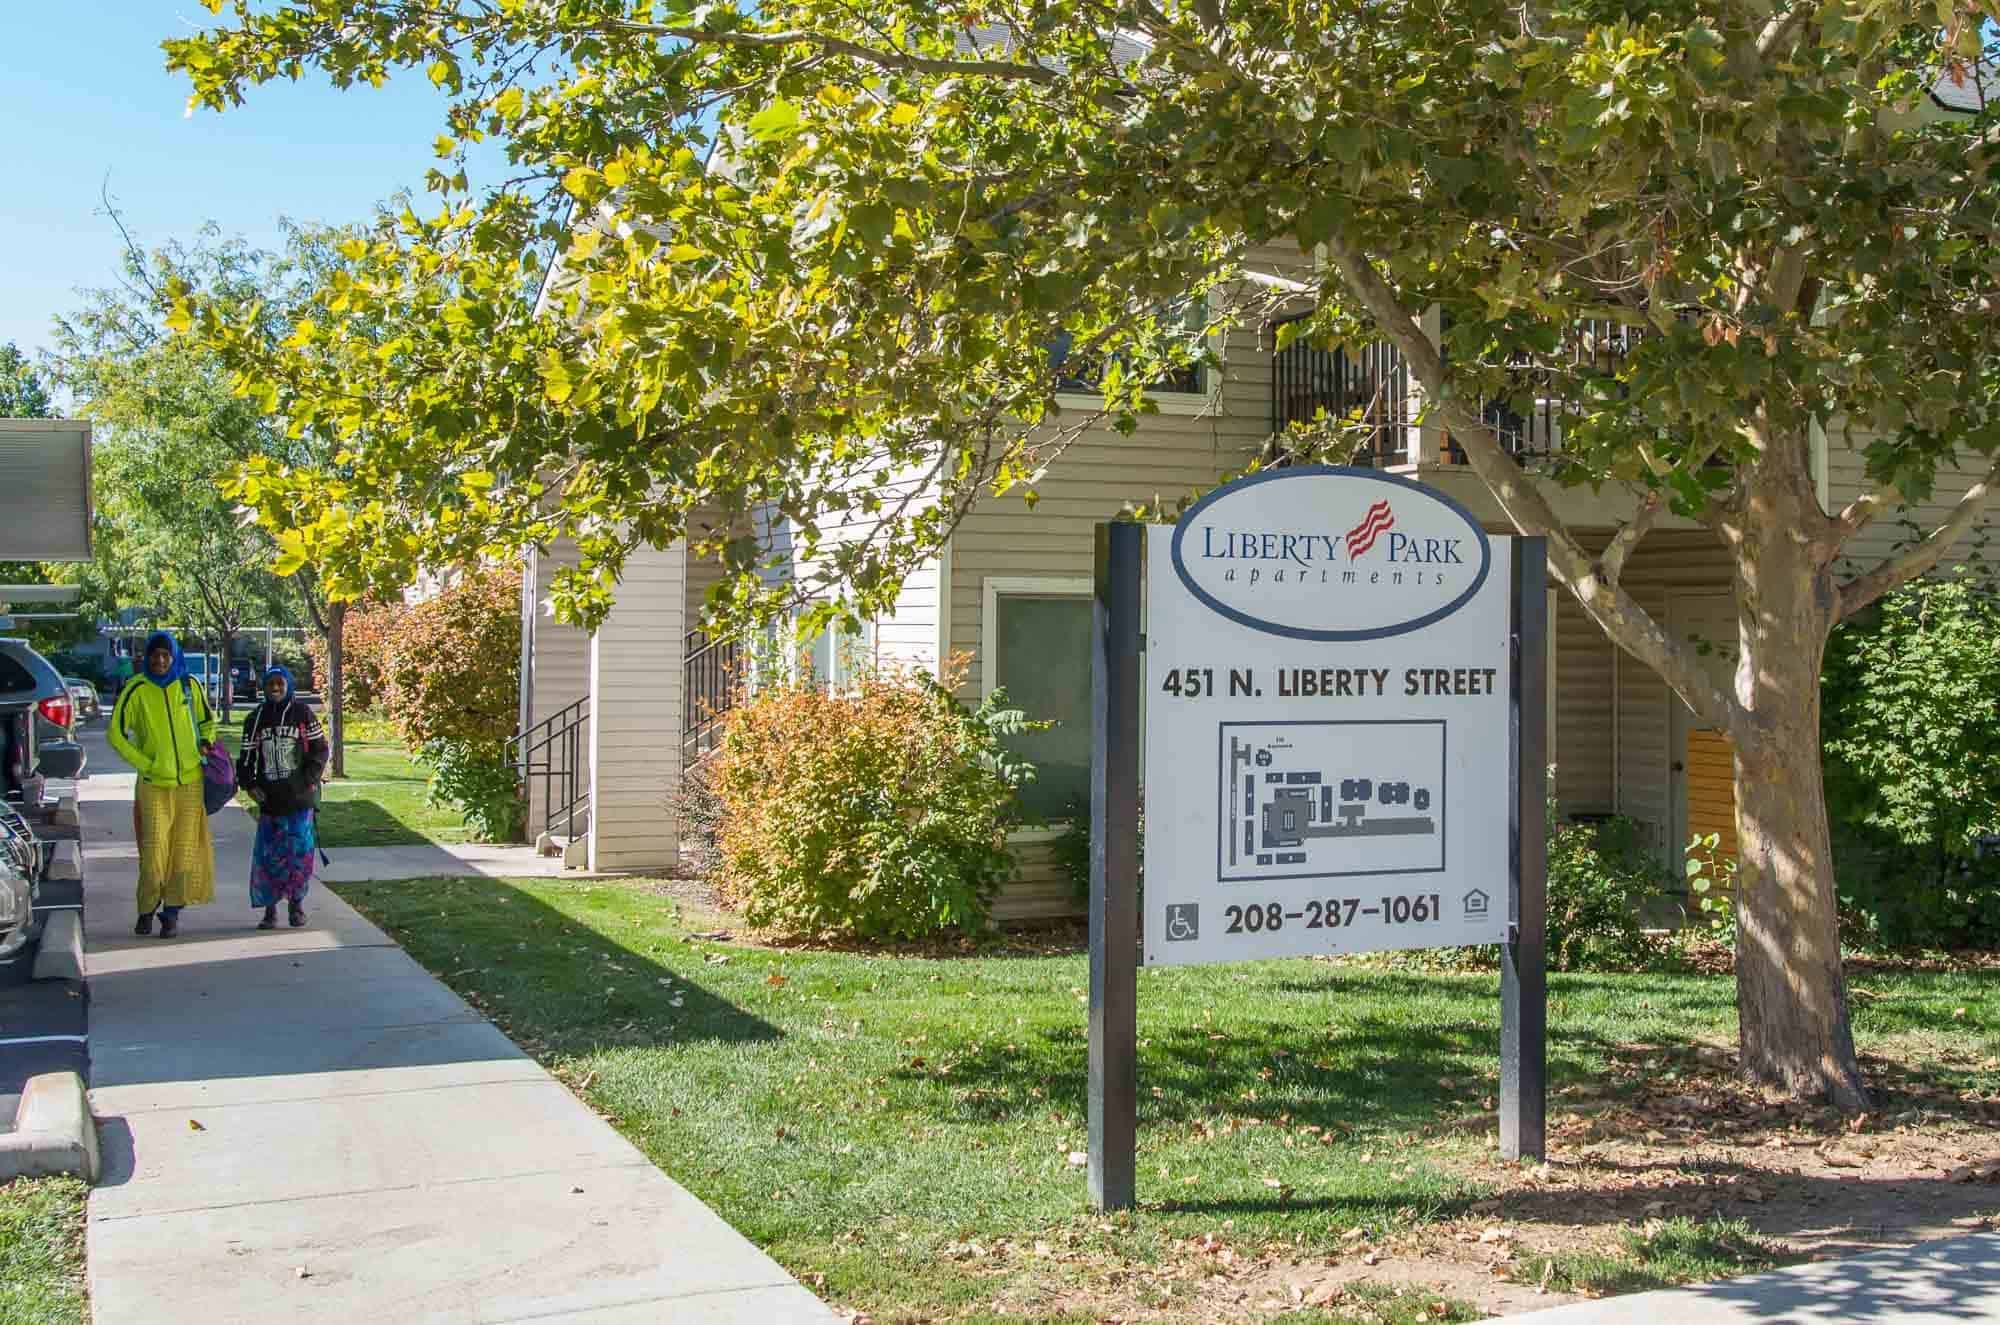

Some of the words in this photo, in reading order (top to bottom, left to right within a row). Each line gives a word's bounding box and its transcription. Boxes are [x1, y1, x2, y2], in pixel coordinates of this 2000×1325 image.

[1202, 526, 1343, 568] LIBERTY
[1387, 532, 1464, 563] PARK
[1224, 567, 1444, 586] apartments
[1162, 669, 1213, 697] 451
[1229, 669, 1262, 697] N.
[1278, 669, 1390, 697] LIBERTY
[1403, 668, 1496, 696] STREET
[1224, 894, 1441, 934] 208-287-1061
